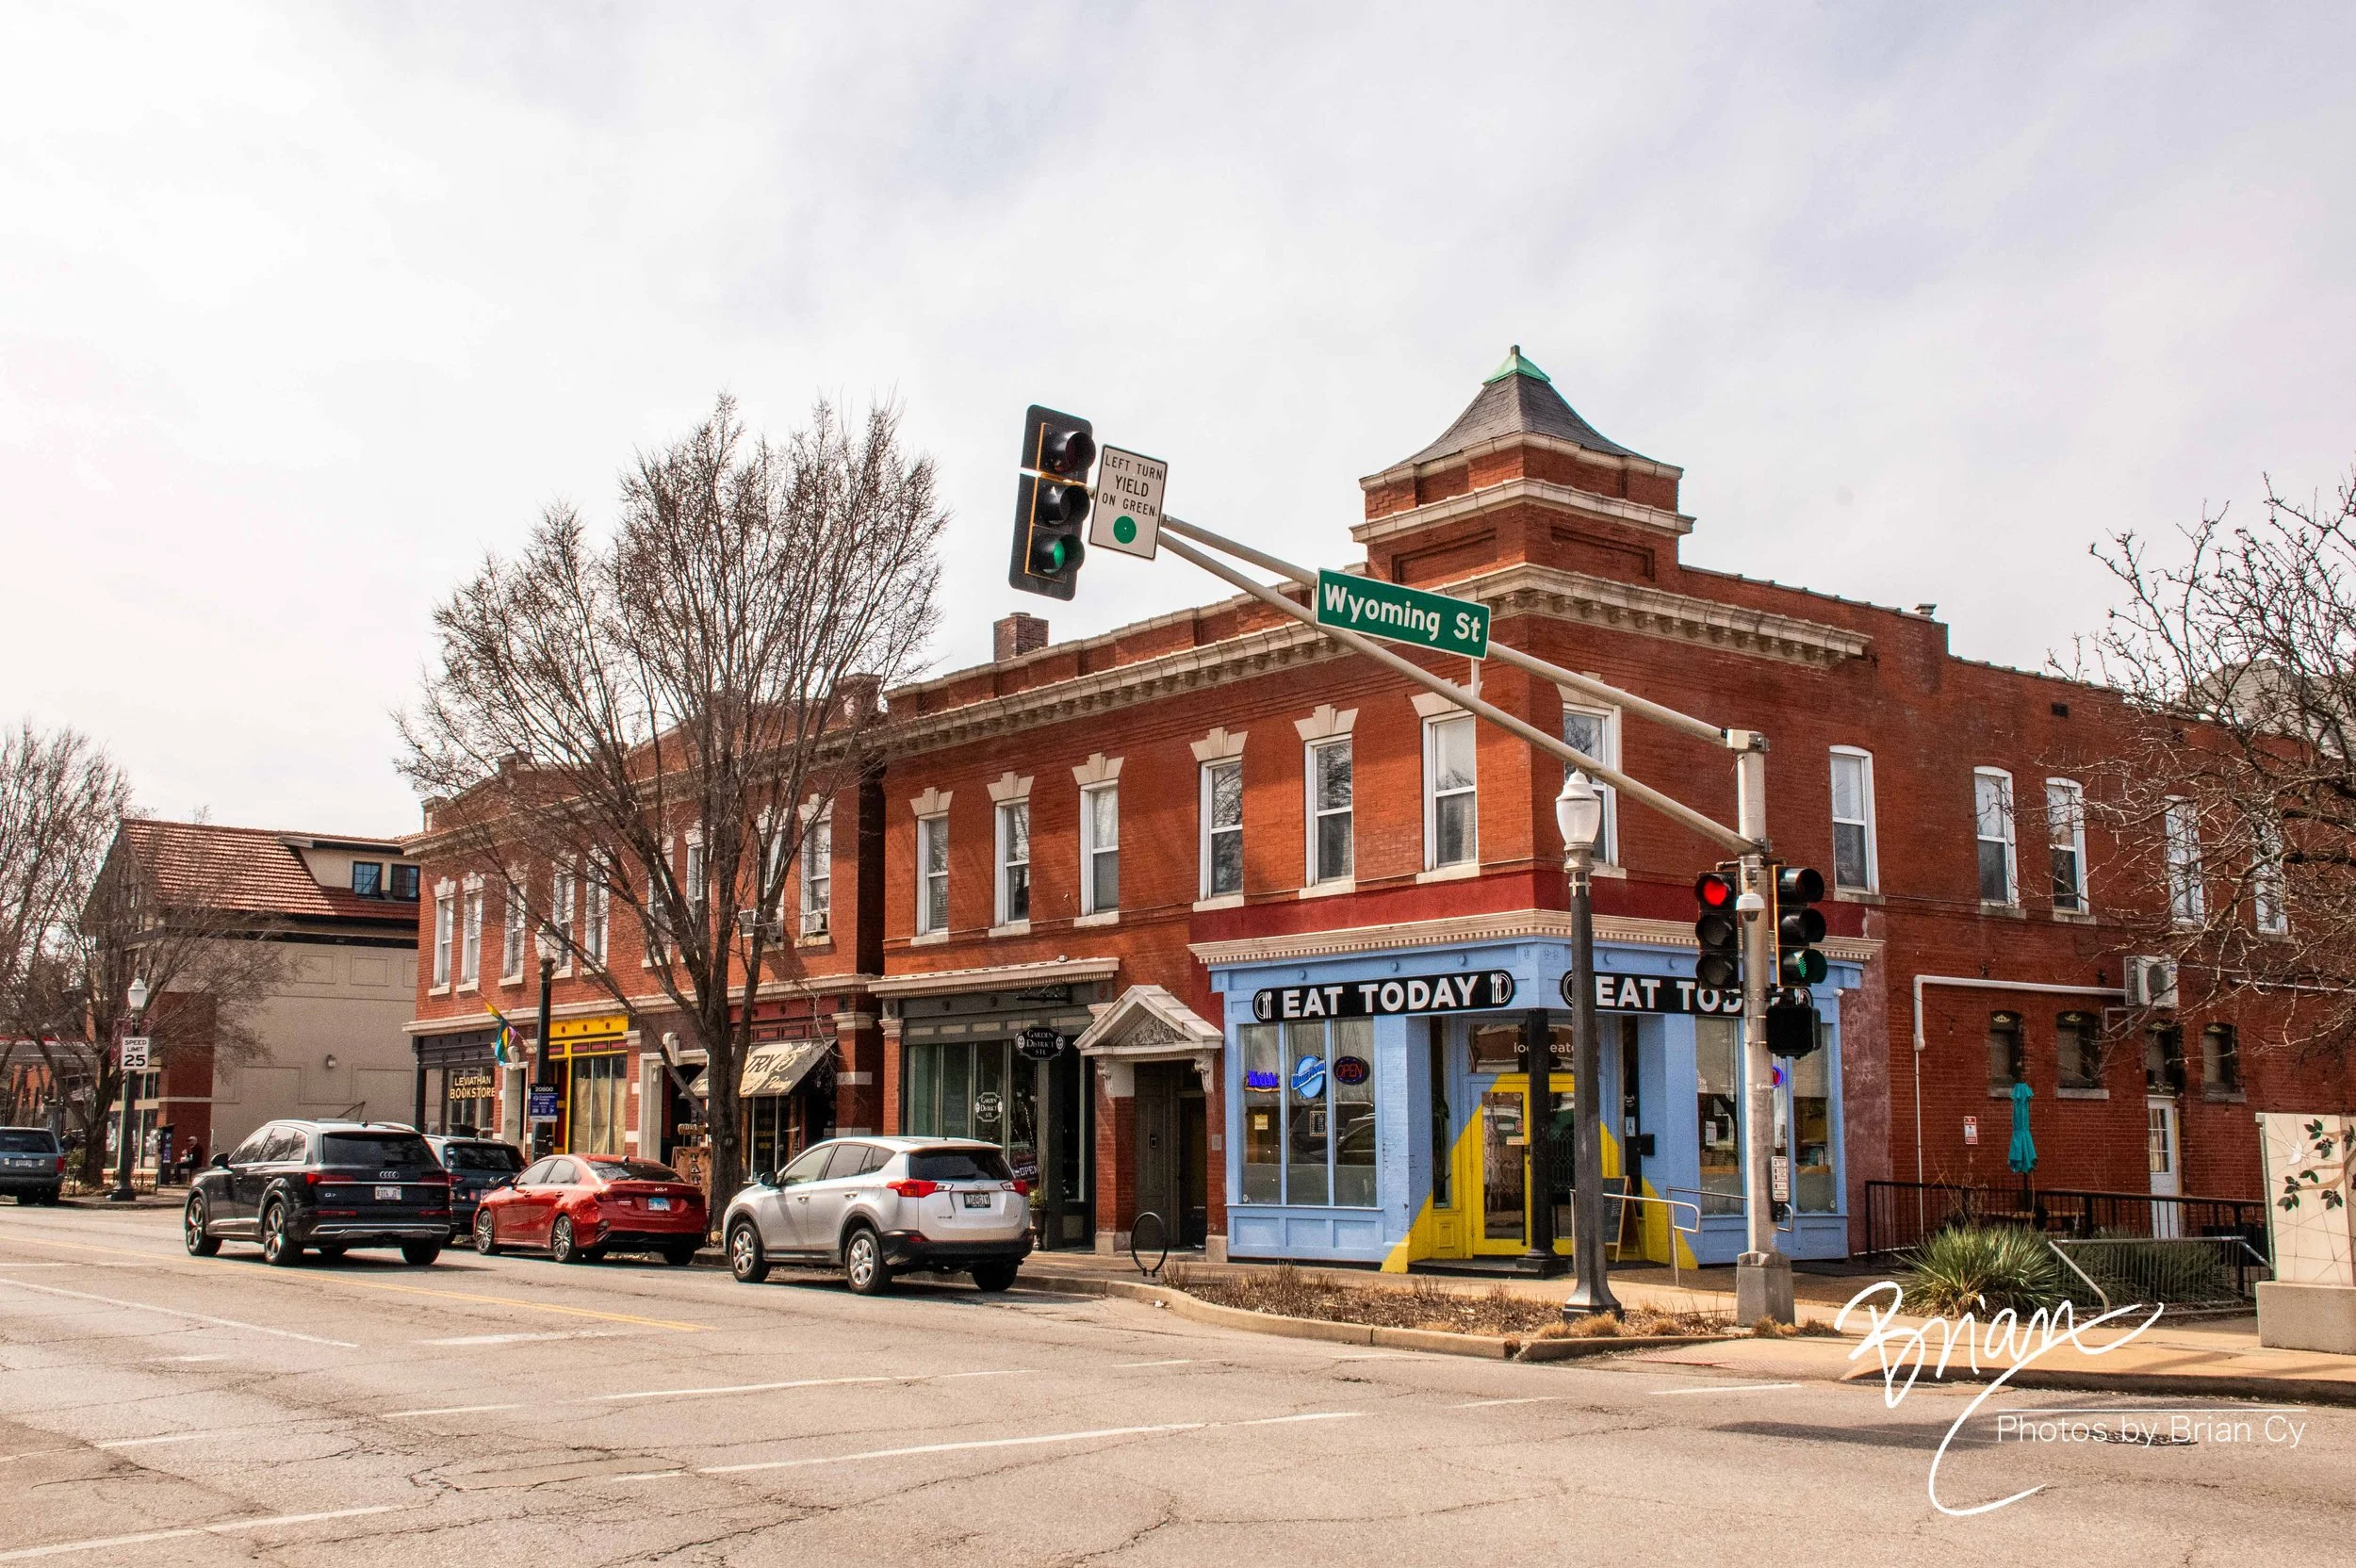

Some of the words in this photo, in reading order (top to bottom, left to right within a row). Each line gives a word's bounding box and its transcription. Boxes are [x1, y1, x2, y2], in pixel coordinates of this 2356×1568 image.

[1104, 454, 1130, 471] LEFT
[1137, 463, 1163, 481] TURN
[1115, 475, 1149, 497] YIELD
[1102, 493, 1116, 506] ON
[1122, 498, 1155, 517] GREEN
[1324, 582, 1440, 641] Wyoming
[1453, 612, 1481, 643] St
[1283, 986, 1343, 1019] EAT
[1358, 975, 1479, 1014] TODAY
[1595, 975, 1660, 1009] EAT
[1677, 981, 1784, 1012] TOD
[1027, 1030, 1054, 1038] GARDEN
[1026, 1038, 1054, 1048] DISTRICT
[124, 1054, 146, 1067] 25
[745, 1054, 779, 1073] TRX
[1335, 1064, 1363, 1078] OPEN
[454, 1075, 492, 1086] LEVIATHAN
[450, 1087, 496, 1100] BOOKSTORE
[1019, 1165, 1040, 1176] OPEN
